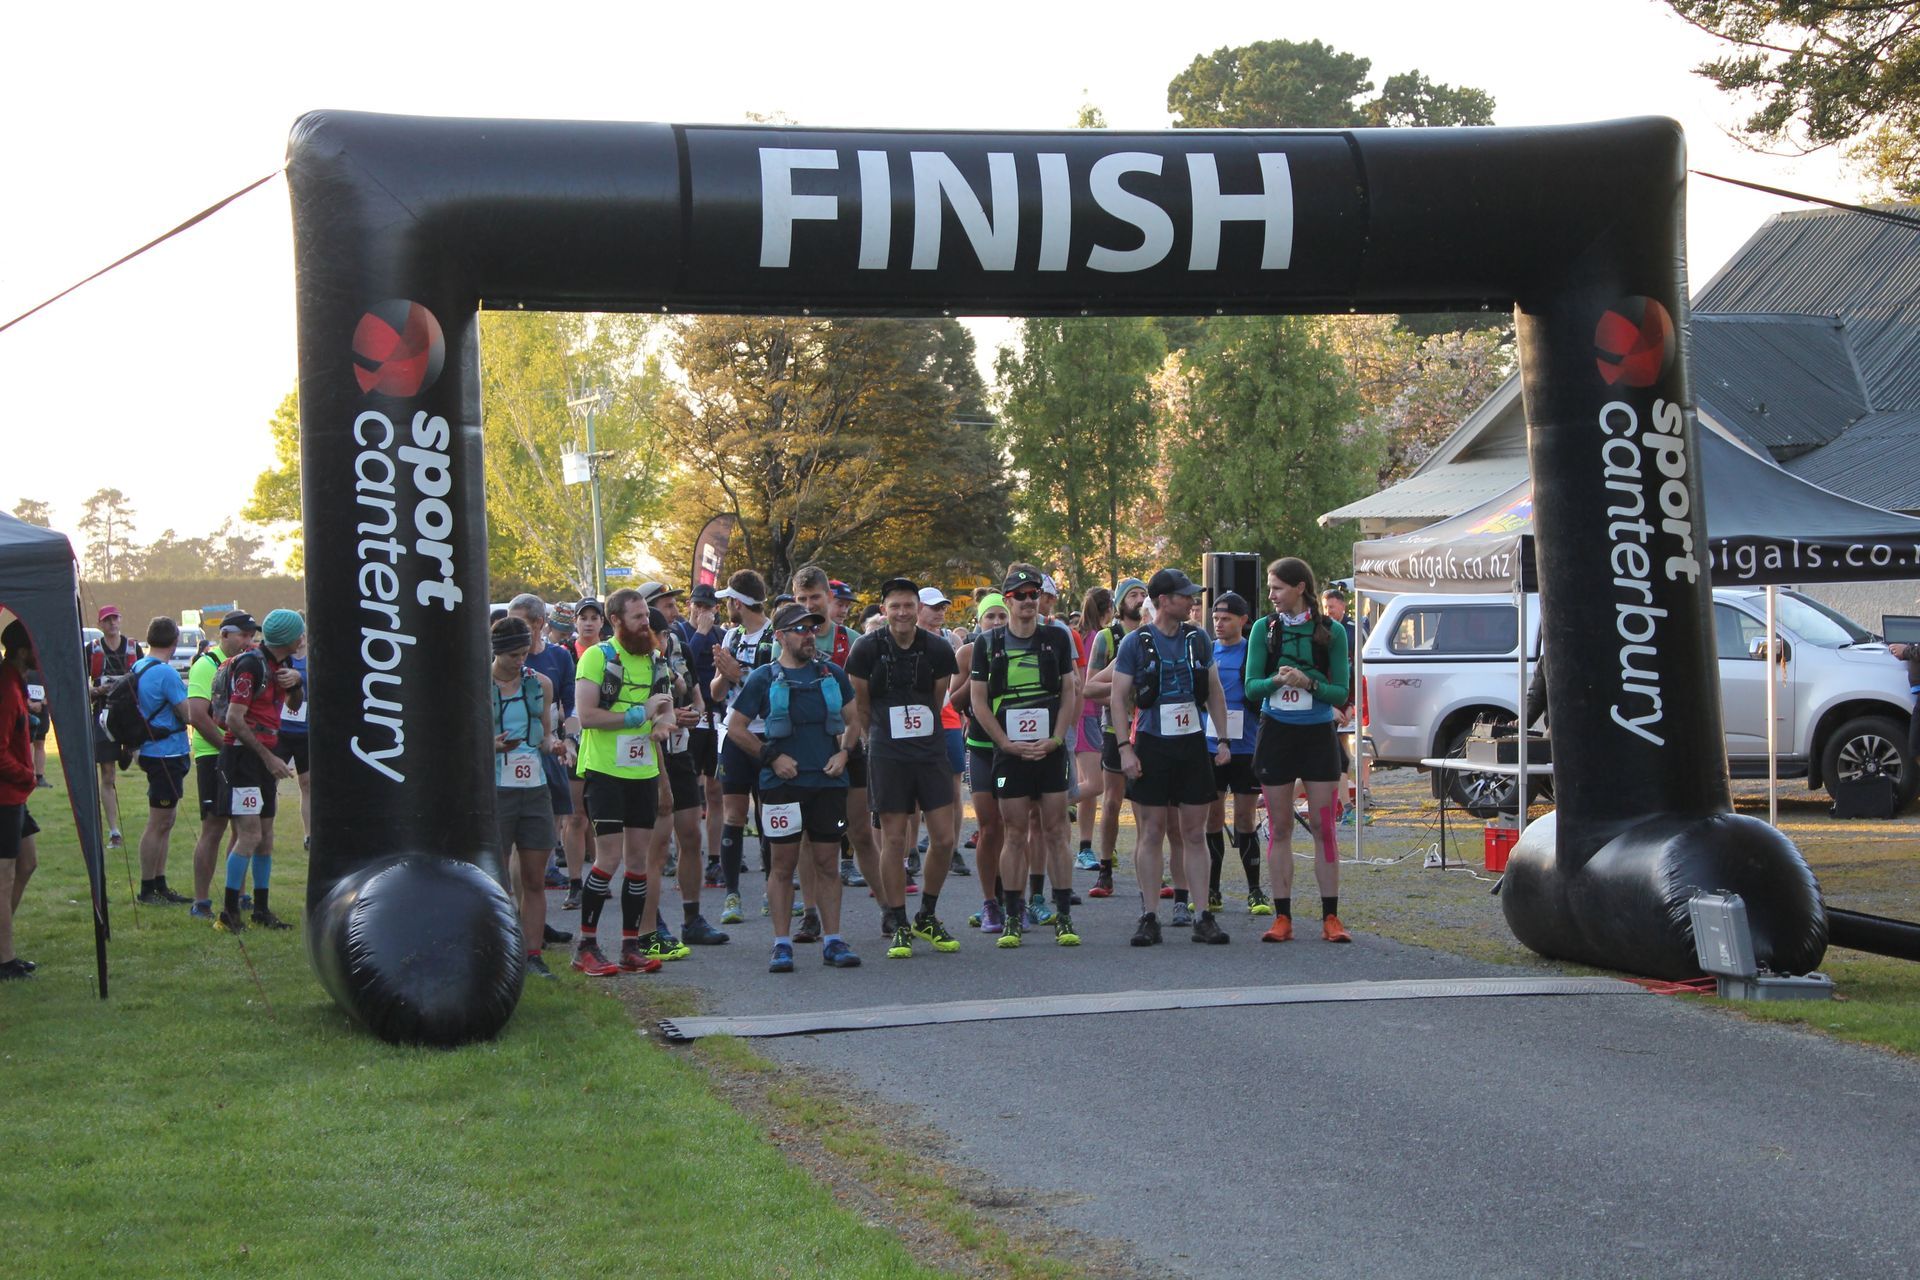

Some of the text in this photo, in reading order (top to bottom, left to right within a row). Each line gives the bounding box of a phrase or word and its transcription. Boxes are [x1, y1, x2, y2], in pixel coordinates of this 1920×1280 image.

[759, 147, 1293, 273] FINISH
[1642, 398, 1700, 583] sport
[398, 410, 463, 611] sport
[1709, 538, 1920, 579] igals.co.
[1360, 548, 1510, 587] www.bigals.co.nz
[1599, 401, 1667, 746] canterbury
[351, 411, 416, 782] canterbury
[1281, 690, 1299, 703] 40
[904, 716, 922, 729] 55
[1019, 719, 1037, 732] 22
[1175, 713, 1189, 727] 14
[675, 734, 683, 746] 7
[629, 746, 644, 759] 54
[515, 764, 531, 778] 63
[242, 797, 257, 808] 49
[770, 815, 788, 829] 66
